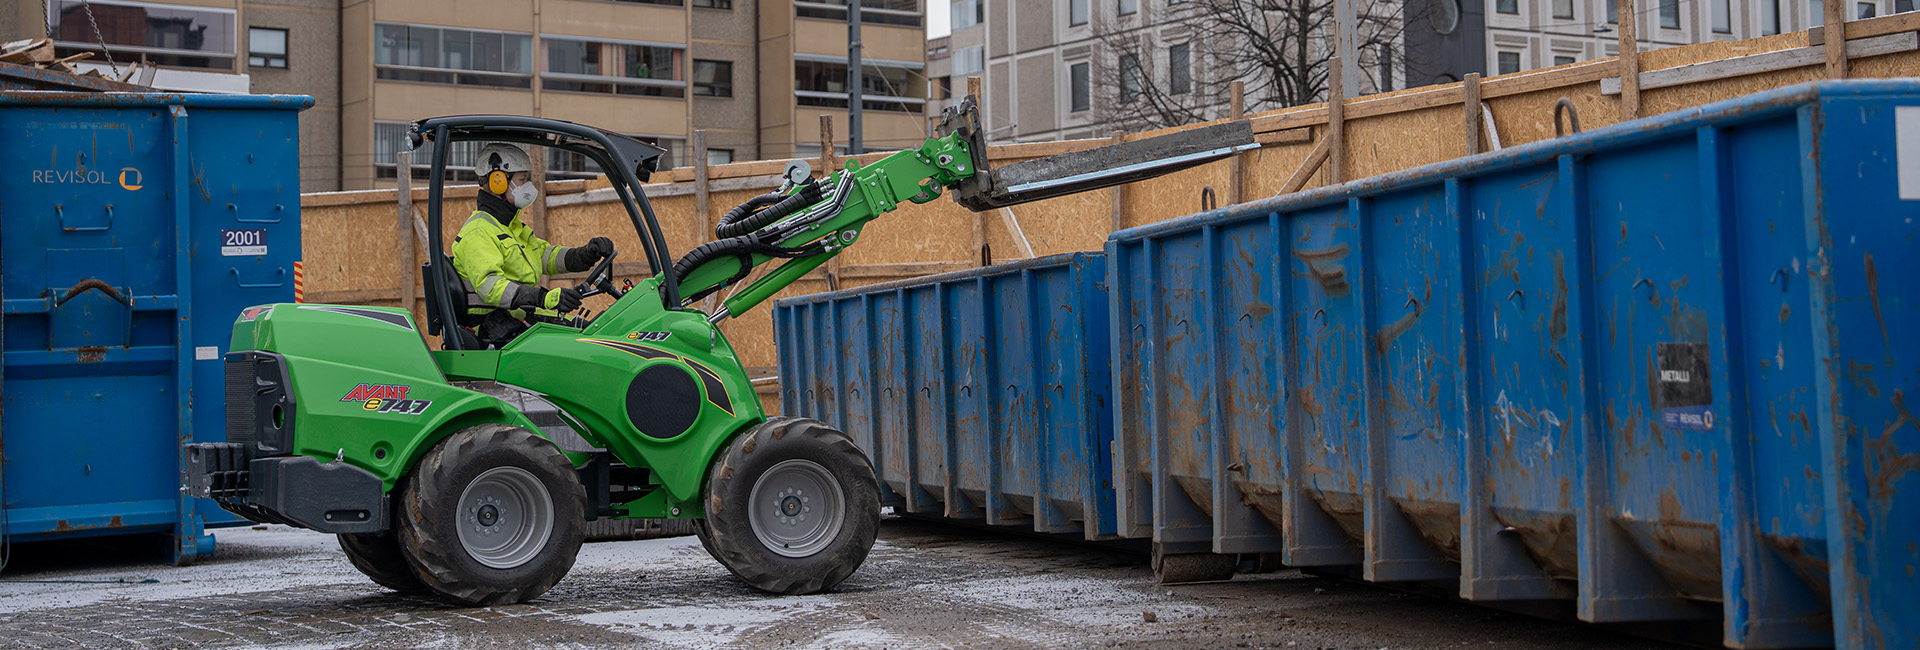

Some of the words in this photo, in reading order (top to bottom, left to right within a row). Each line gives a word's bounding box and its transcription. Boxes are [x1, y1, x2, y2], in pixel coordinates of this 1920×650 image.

[32, 169, 111, 184] REVISOL
[226, 231, 260, 245] 2001
[627, 331, 672, 341] e747
[1661, 370, 1690, 382] METALLI
[340, 383, 410, 402] AVANT
[363, 398, 432, 415] e747
[1680, 413, 1703, 424] REVISOL
